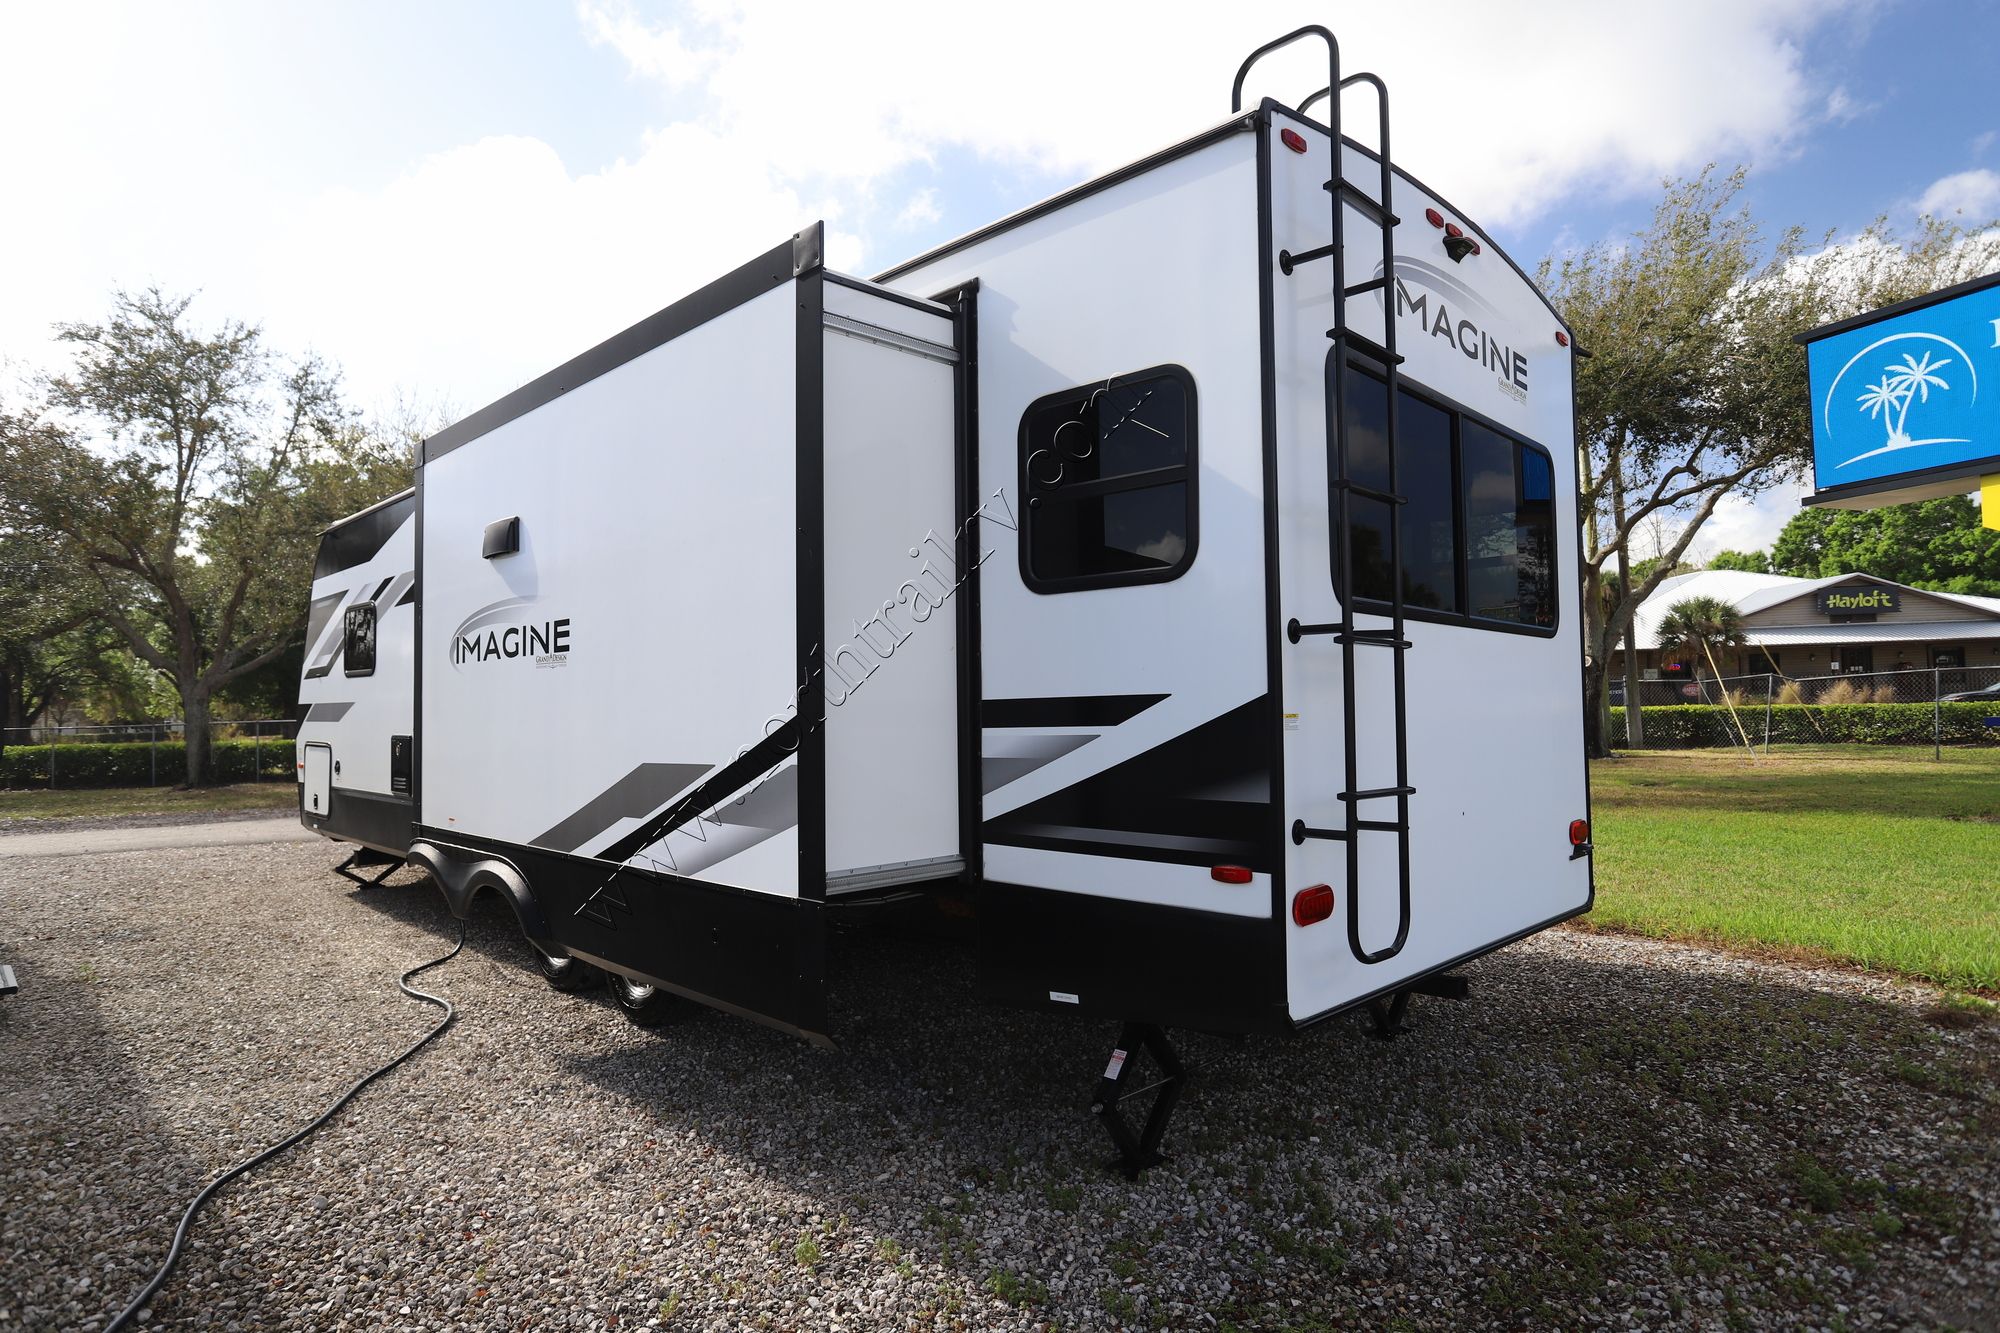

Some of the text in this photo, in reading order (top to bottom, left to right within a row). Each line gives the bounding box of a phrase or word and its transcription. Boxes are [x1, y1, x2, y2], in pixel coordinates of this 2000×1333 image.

[1396, 274, 1528, 392] MAGINE
[1826, 590, 1893, 609] Hayloft
[456, 618, 570, 664] IMAGINE
